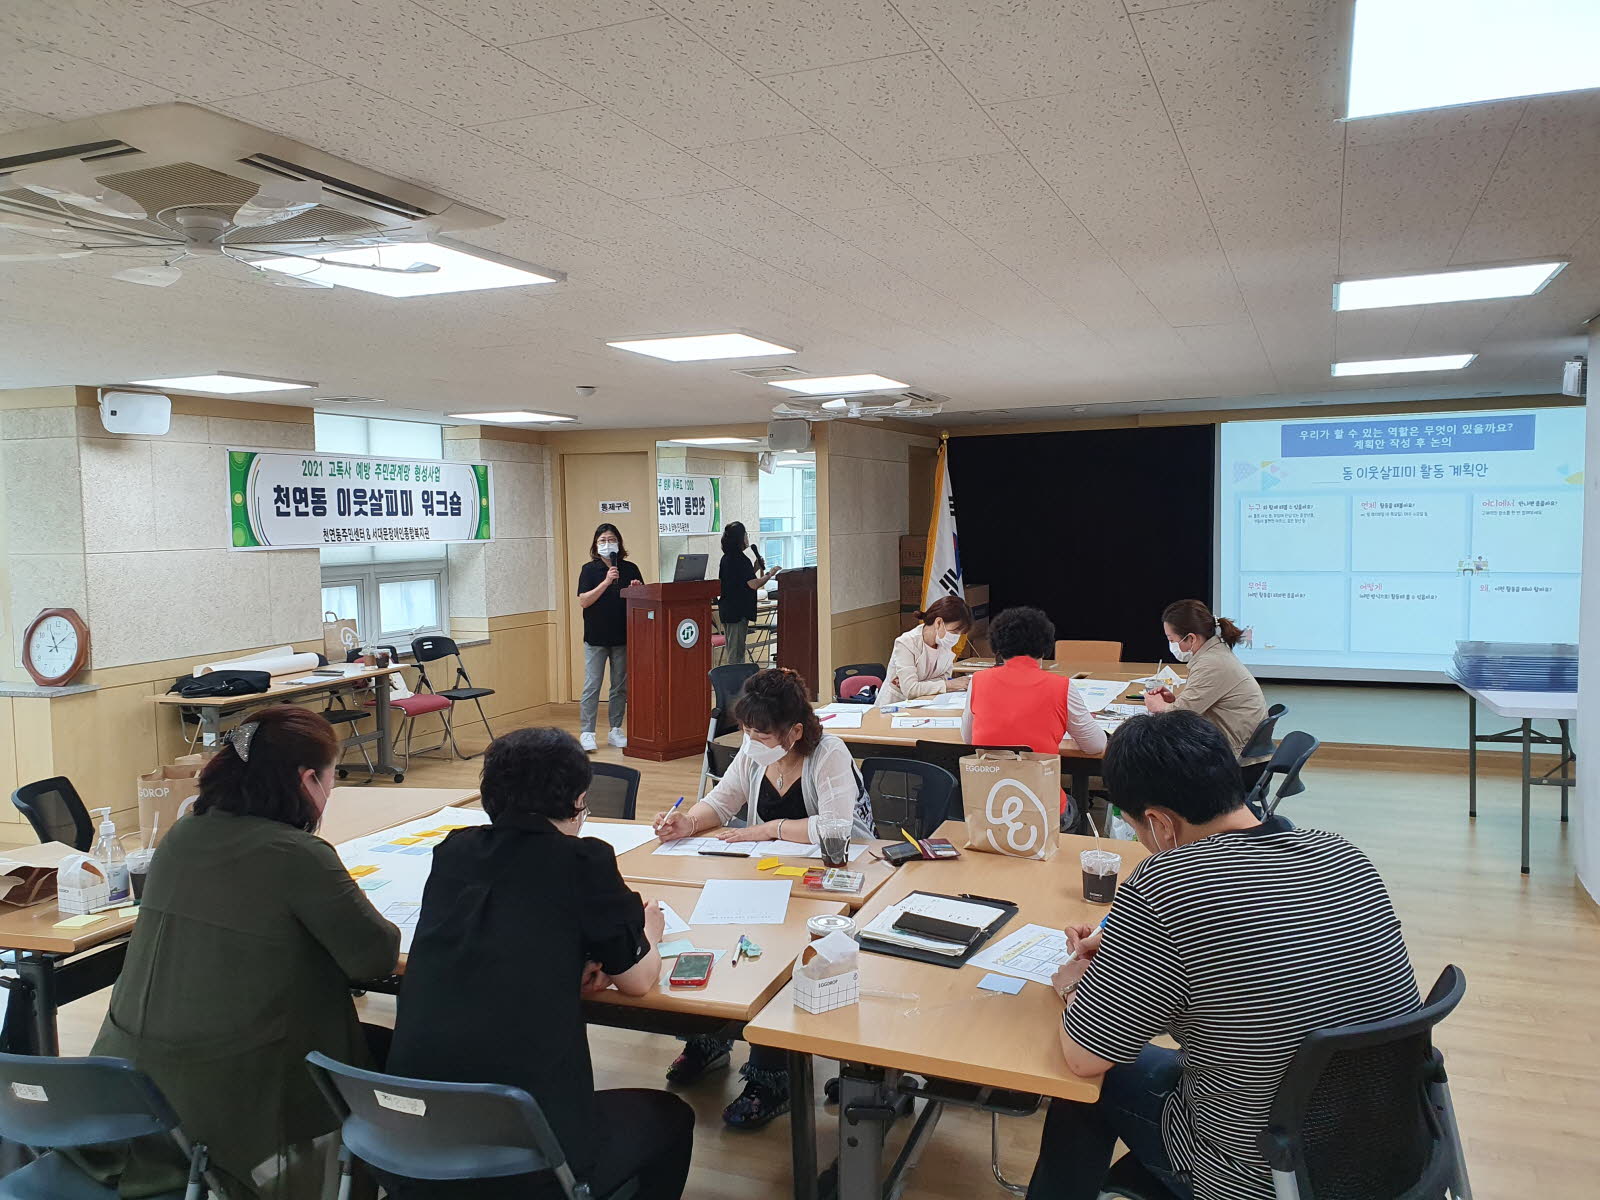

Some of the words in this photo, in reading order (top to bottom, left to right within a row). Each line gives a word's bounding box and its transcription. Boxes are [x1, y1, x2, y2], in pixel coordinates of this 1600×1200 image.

[1299, 430, 1330, 441] 우리가
[1334, 429, 1344, 439] 할
[1348, 429, 1358, 439] 수
[1362, 428, 1383, 438] 있는
[1388, 426, 1420, 437] 역할은
[1424, 424, 1457, 435] 무엇이
[1462, 423, 1513, 434] 있을까요?
[1354, 438, 1385, 449] 계획안
[1390, 438, 1411, 449] 작성
[1415, 438, 1425, 448] 후
[1430, 437, 1452, 447] 논의
[302, 460, 324, 477] 2021
[328, 461, 352, 479] 고독사
[355, 462, 370, 480] 예방
[375, 463, 410, 481] 주민관계망
[414, 465, 441, 483] 형성사업
[1342, 466, 1353, 480] 동
[1356, 465, 1416, 480] 이웃살피미
[1420, 464, 1444, 479] 활동
[1449, 463, 1488, 478] 계획안
[273, 484, 328, 517] 천연동
[337, 487, 414, 517] 이웃살피미
[421, 490, 462, 517] 워크숍
[601, 502, 630, 511] 통제구역
[323, 528, 365, 542] 천연동주민센터
[965, 764, 1000, 773] EGGDROP
